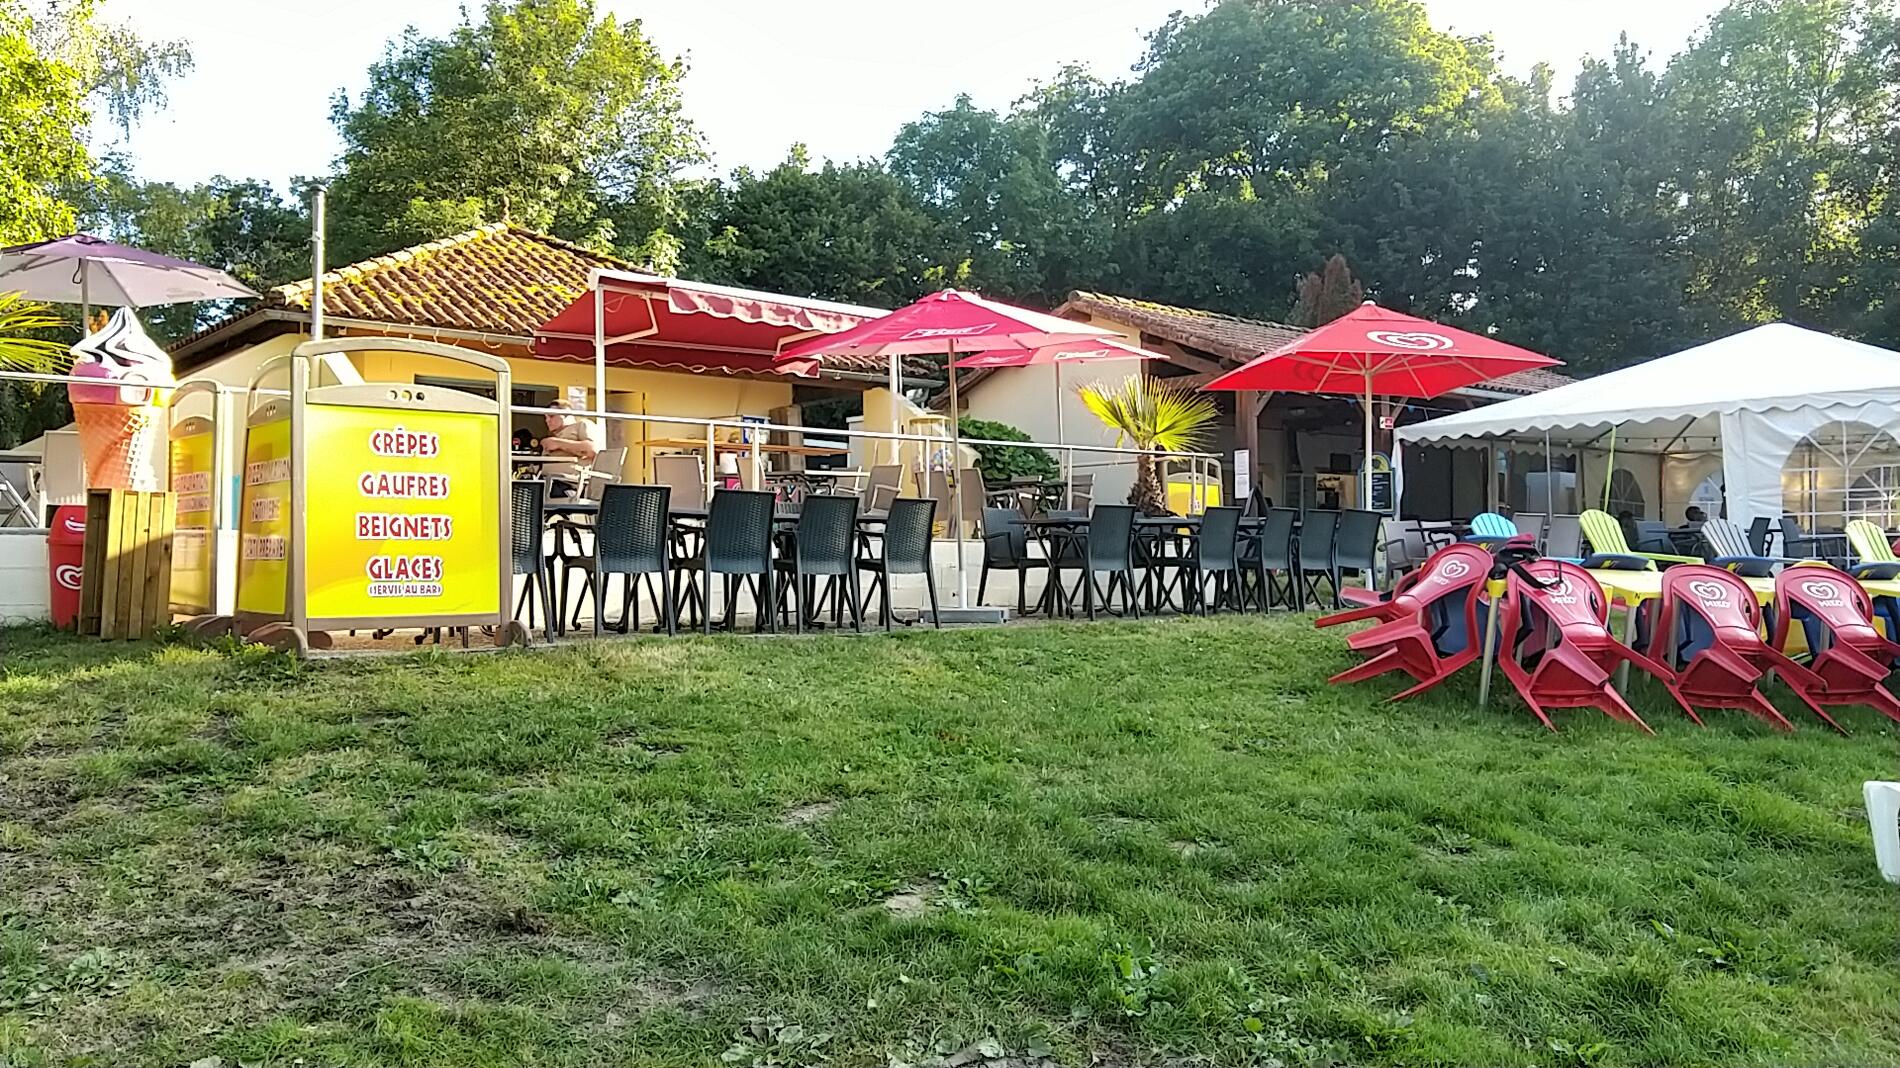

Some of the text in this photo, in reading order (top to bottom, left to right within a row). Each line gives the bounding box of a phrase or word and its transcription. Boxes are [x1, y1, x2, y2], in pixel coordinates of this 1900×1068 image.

[371, 427, 438, 455] CRÊPES
[361, 473, 448, 496] GAUFRES
[358, 515, 450, 538] BEIGNETS
[368, 558, 441, 579] GLACES
[404, 584, 418, 594] AU
[1703, 599, 1731, 608] MIKO
[1818, 599, 1844, 608] MIKO
